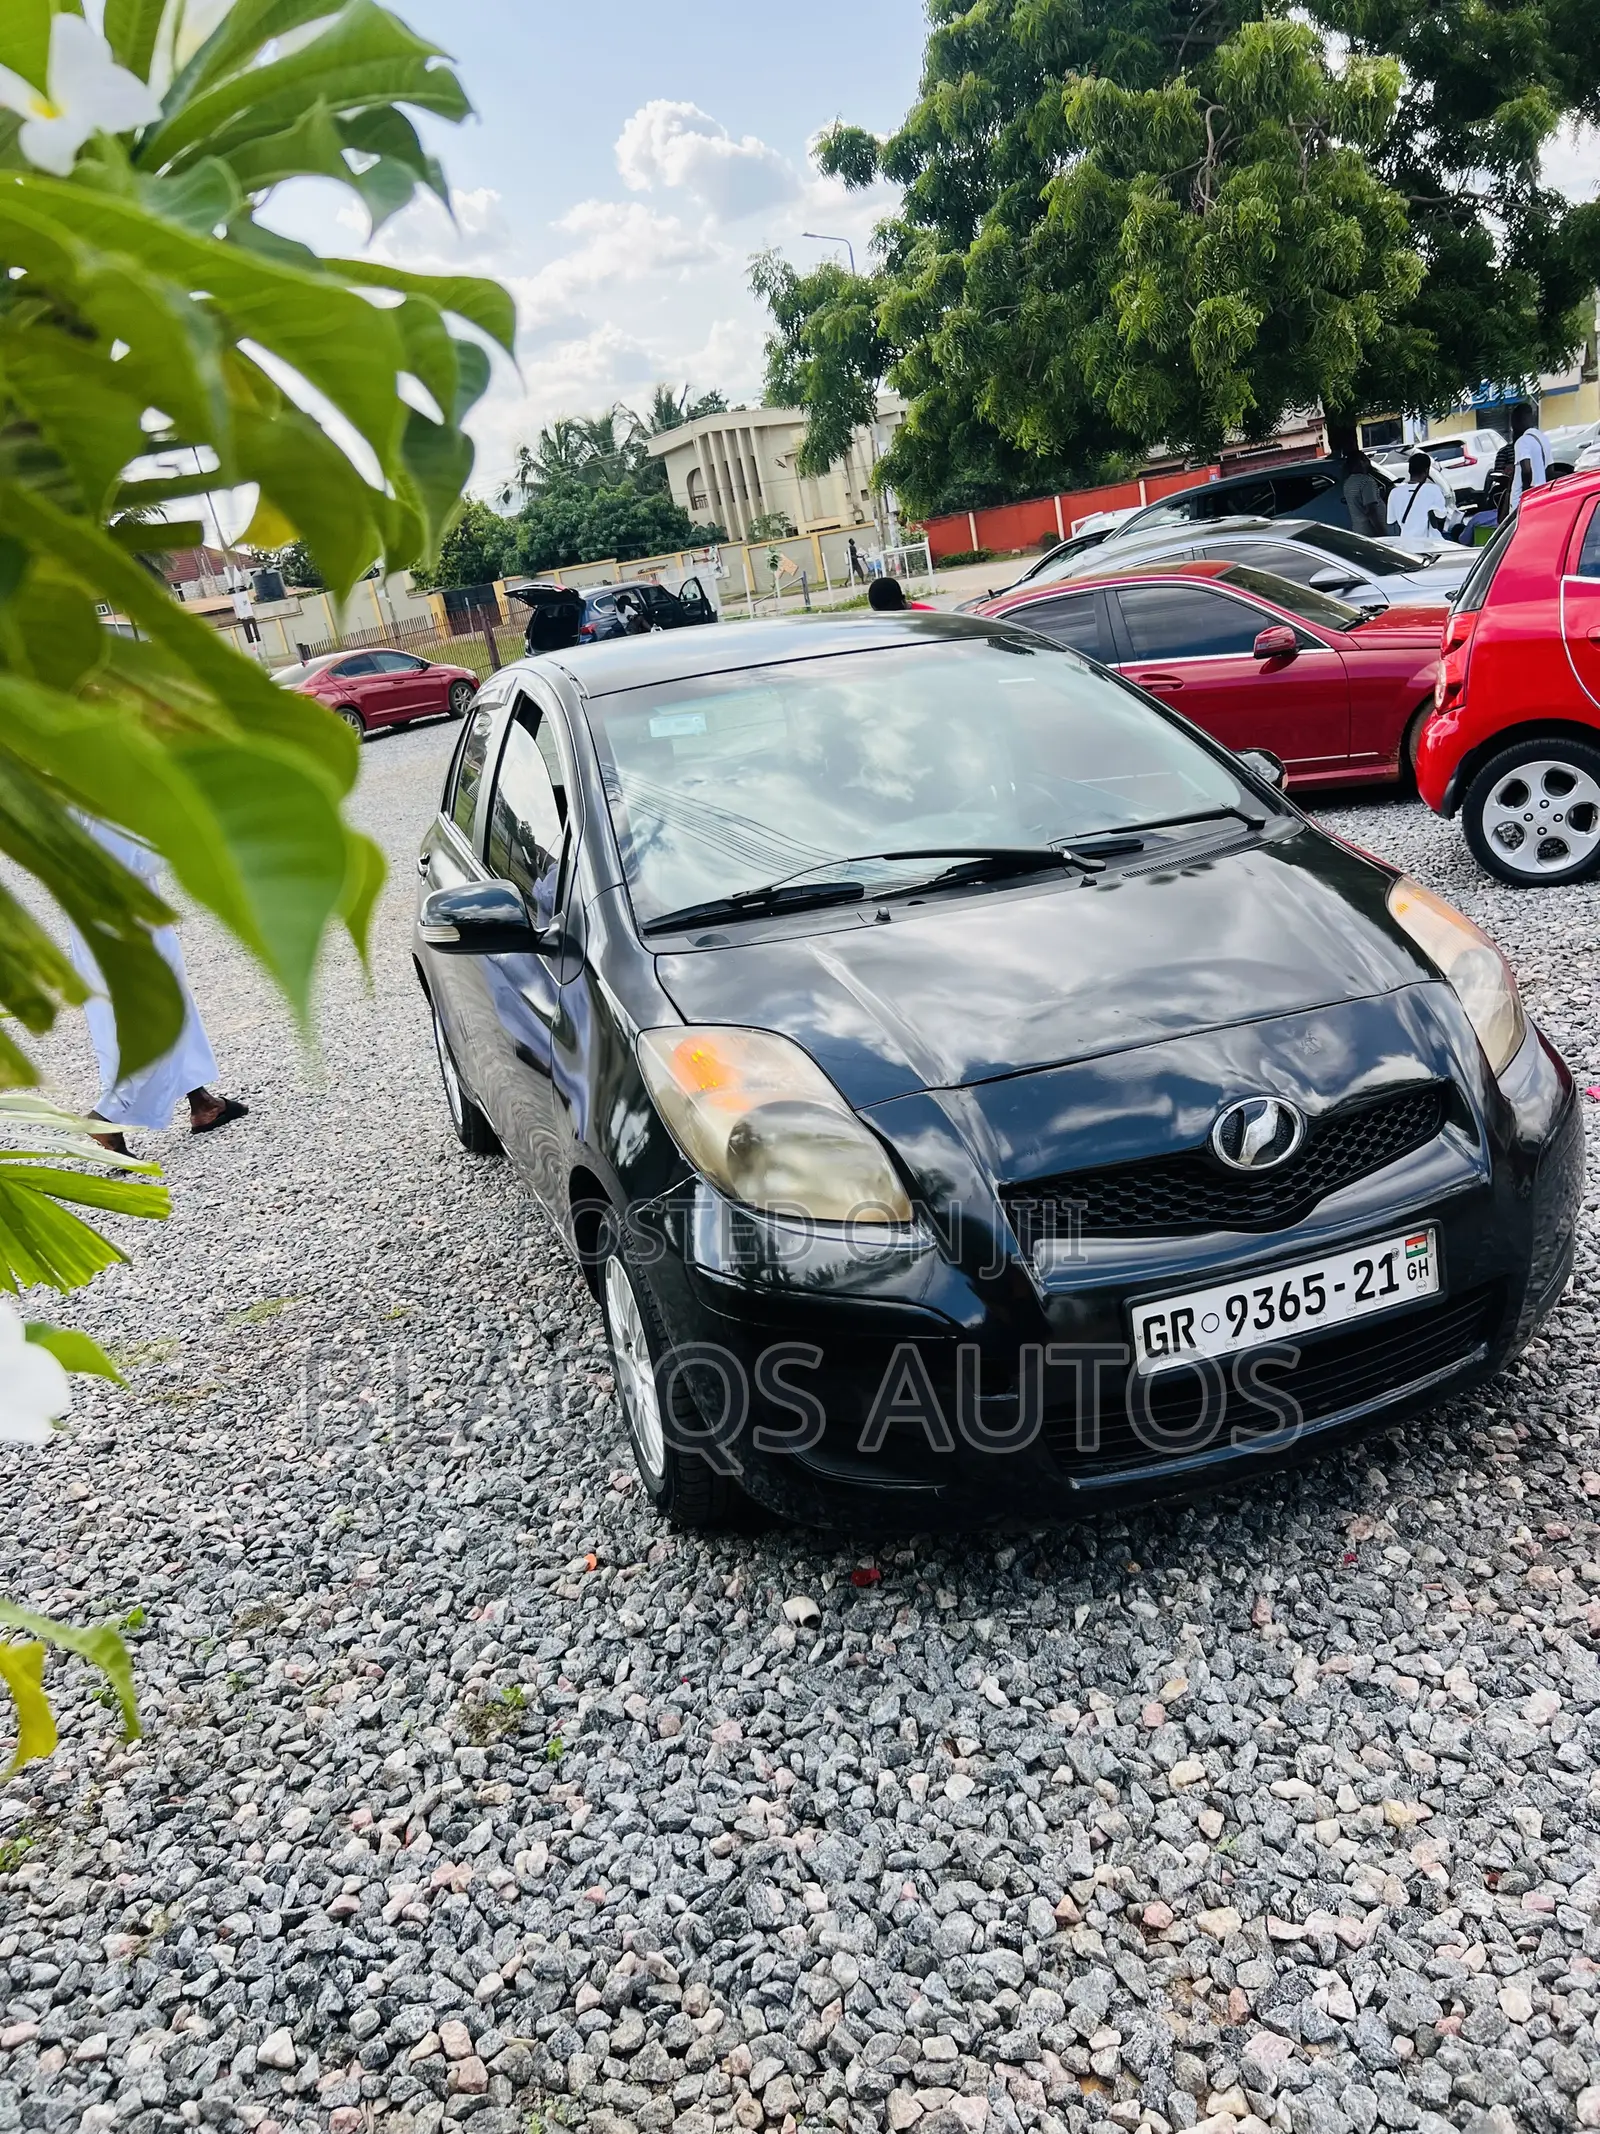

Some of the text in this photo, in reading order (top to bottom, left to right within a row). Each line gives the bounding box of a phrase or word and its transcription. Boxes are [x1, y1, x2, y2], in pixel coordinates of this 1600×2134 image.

[1407, 1258, 1429, 1281] GH
[1143, 1253, 1399, 1358] GR 9365-21
